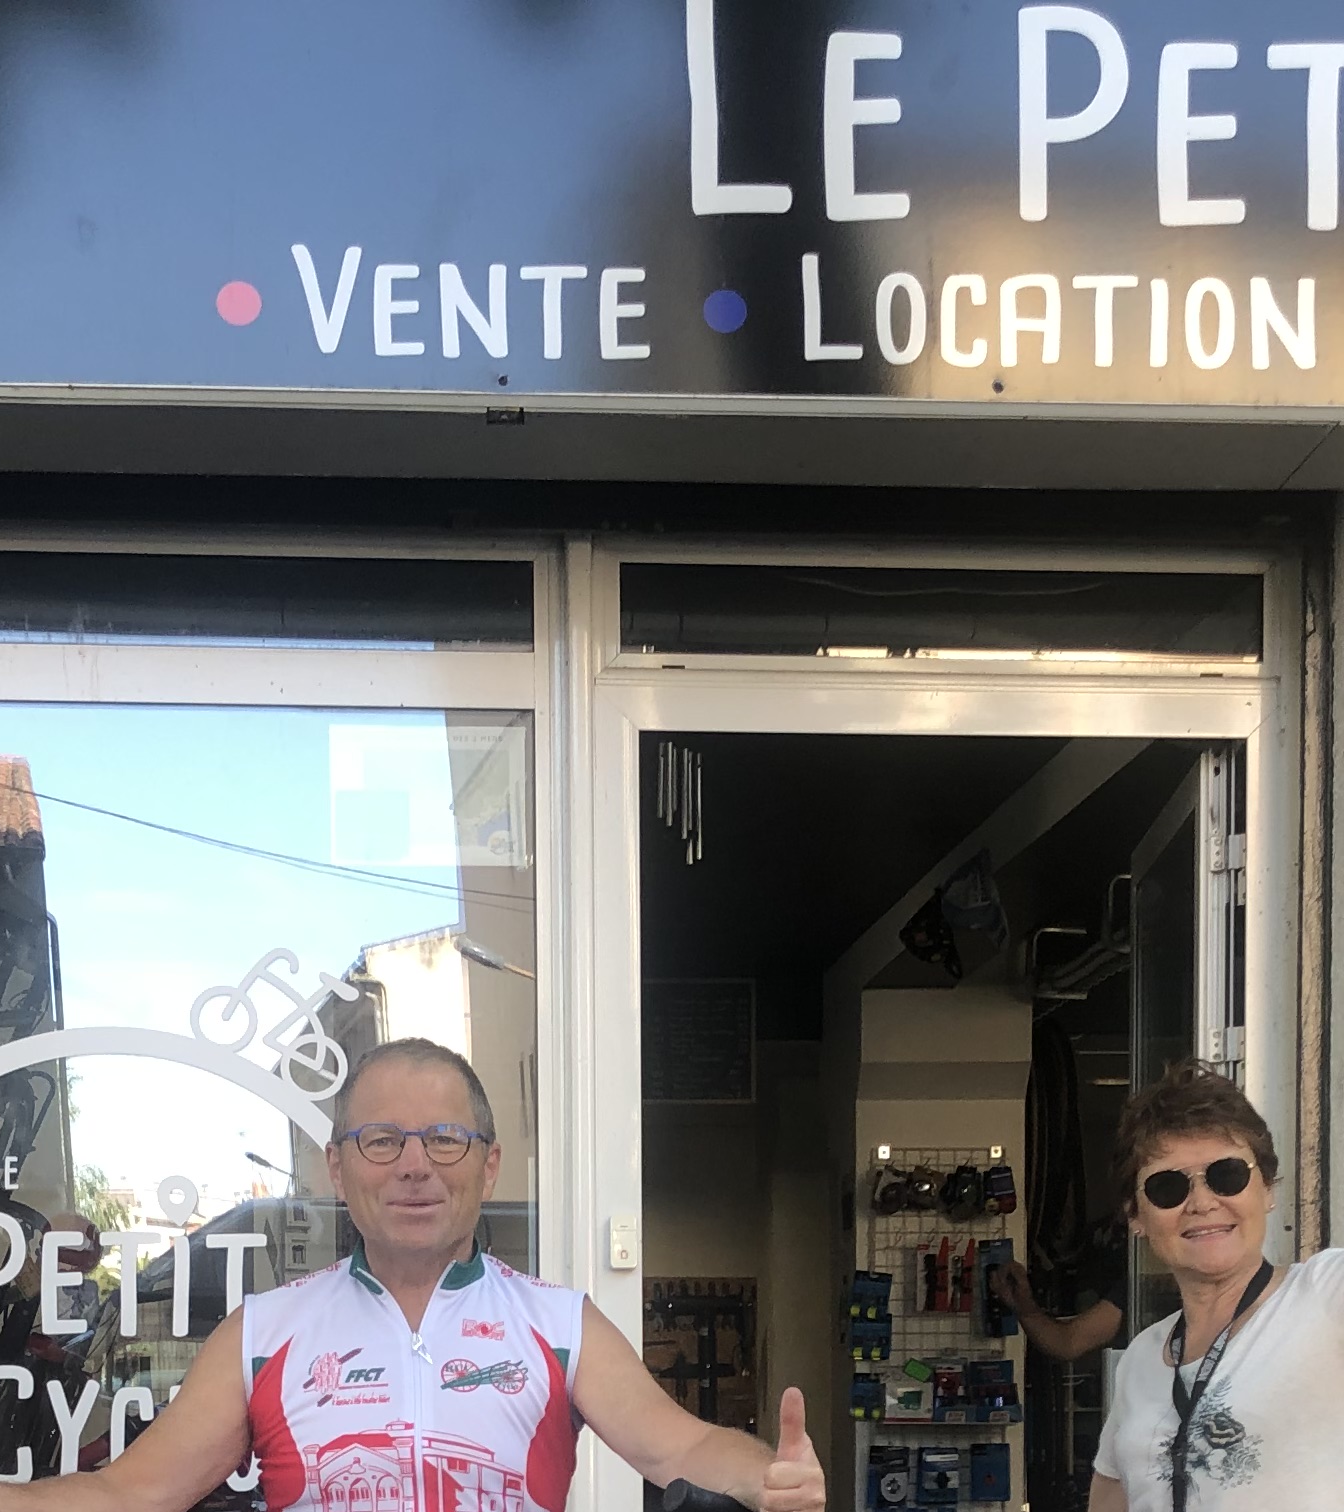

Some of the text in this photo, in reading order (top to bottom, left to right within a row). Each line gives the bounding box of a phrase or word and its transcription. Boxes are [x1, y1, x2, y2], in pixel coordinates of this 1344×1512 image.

[686, 0, 910, 221] LE
[290, 243, 652, 362] VENTE
[801, 251, 1318, 371] LOCATION
[345, 1367, 386, 1383] FFCT
